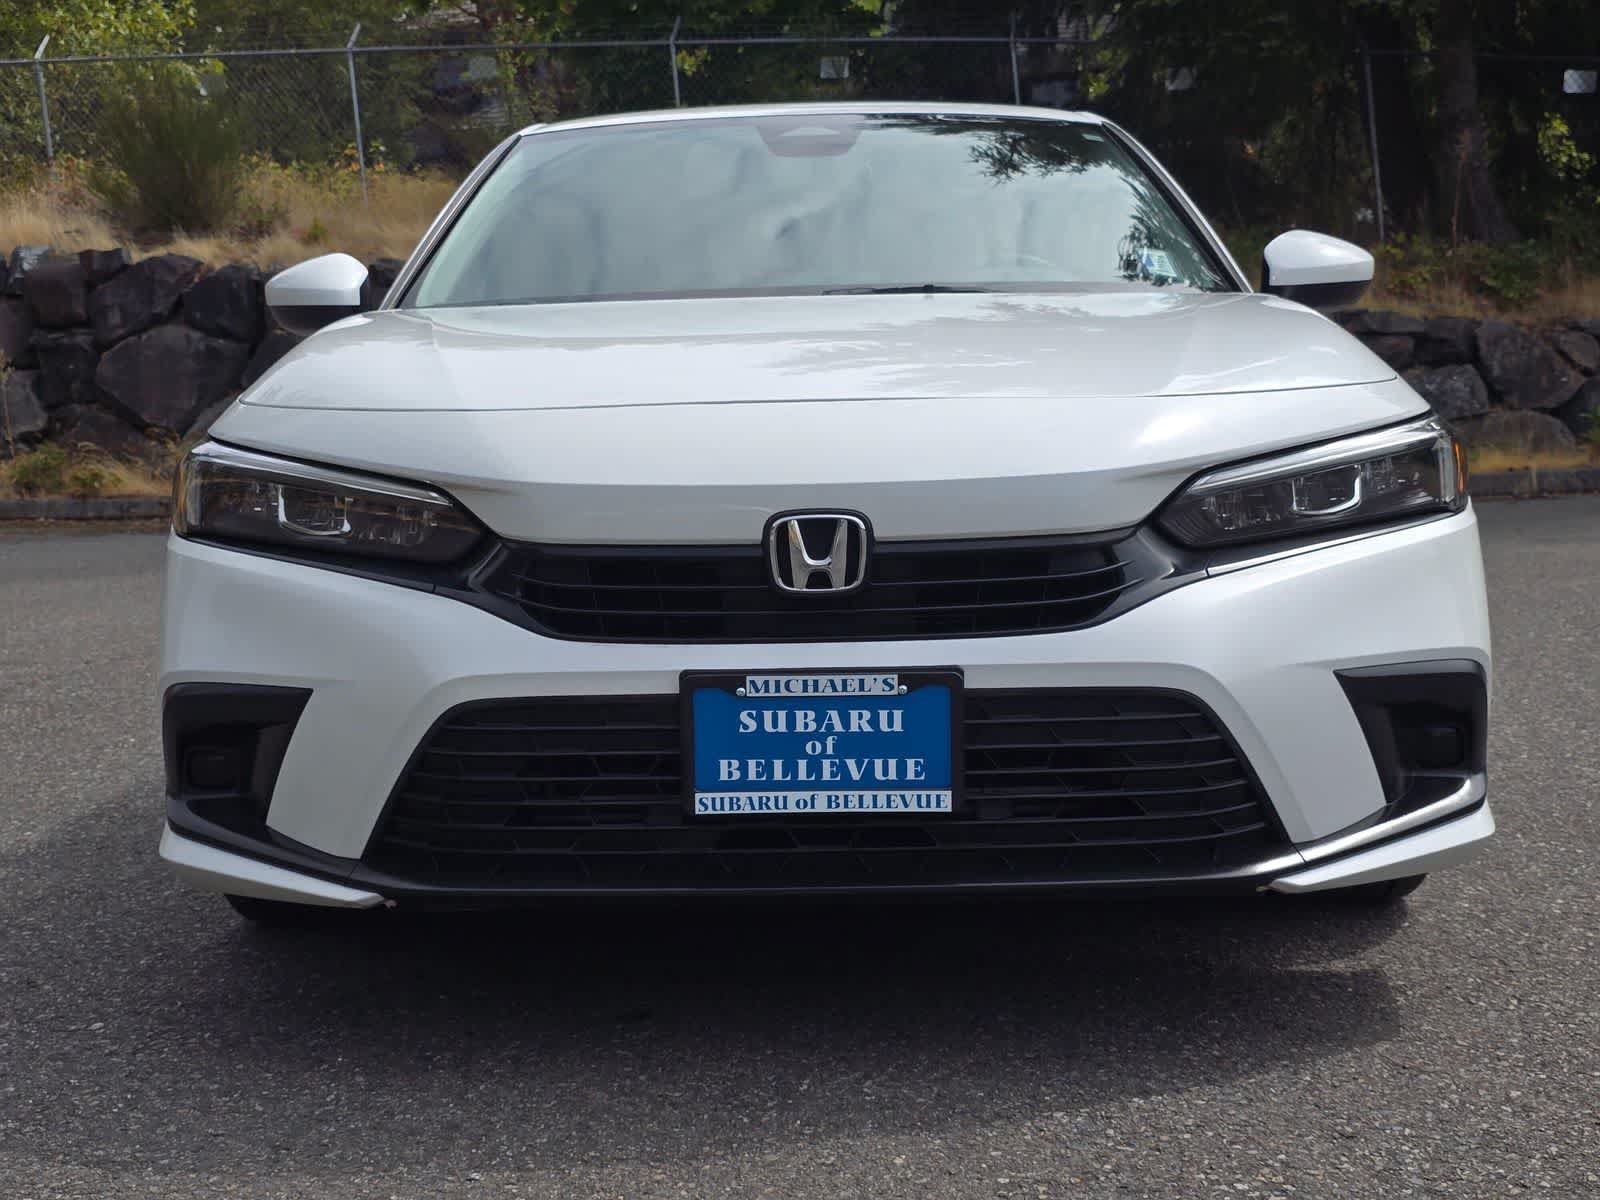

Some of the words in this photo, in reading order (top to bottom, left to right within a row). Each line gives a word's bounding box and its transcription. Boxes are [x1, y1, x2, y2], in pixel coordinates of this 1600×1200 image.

[748, 676, 895, 694] MICHAEL'S
[738, 709, 904, 733] SUBARU
[805, 735, 837, 755] of
[718, 758, 925, 781] BELLEVUE
[698, 795, 788, 812] SUBARU
[795, 794, 819, 810] of
[824, 793, 948, 810] BELLEVUE
